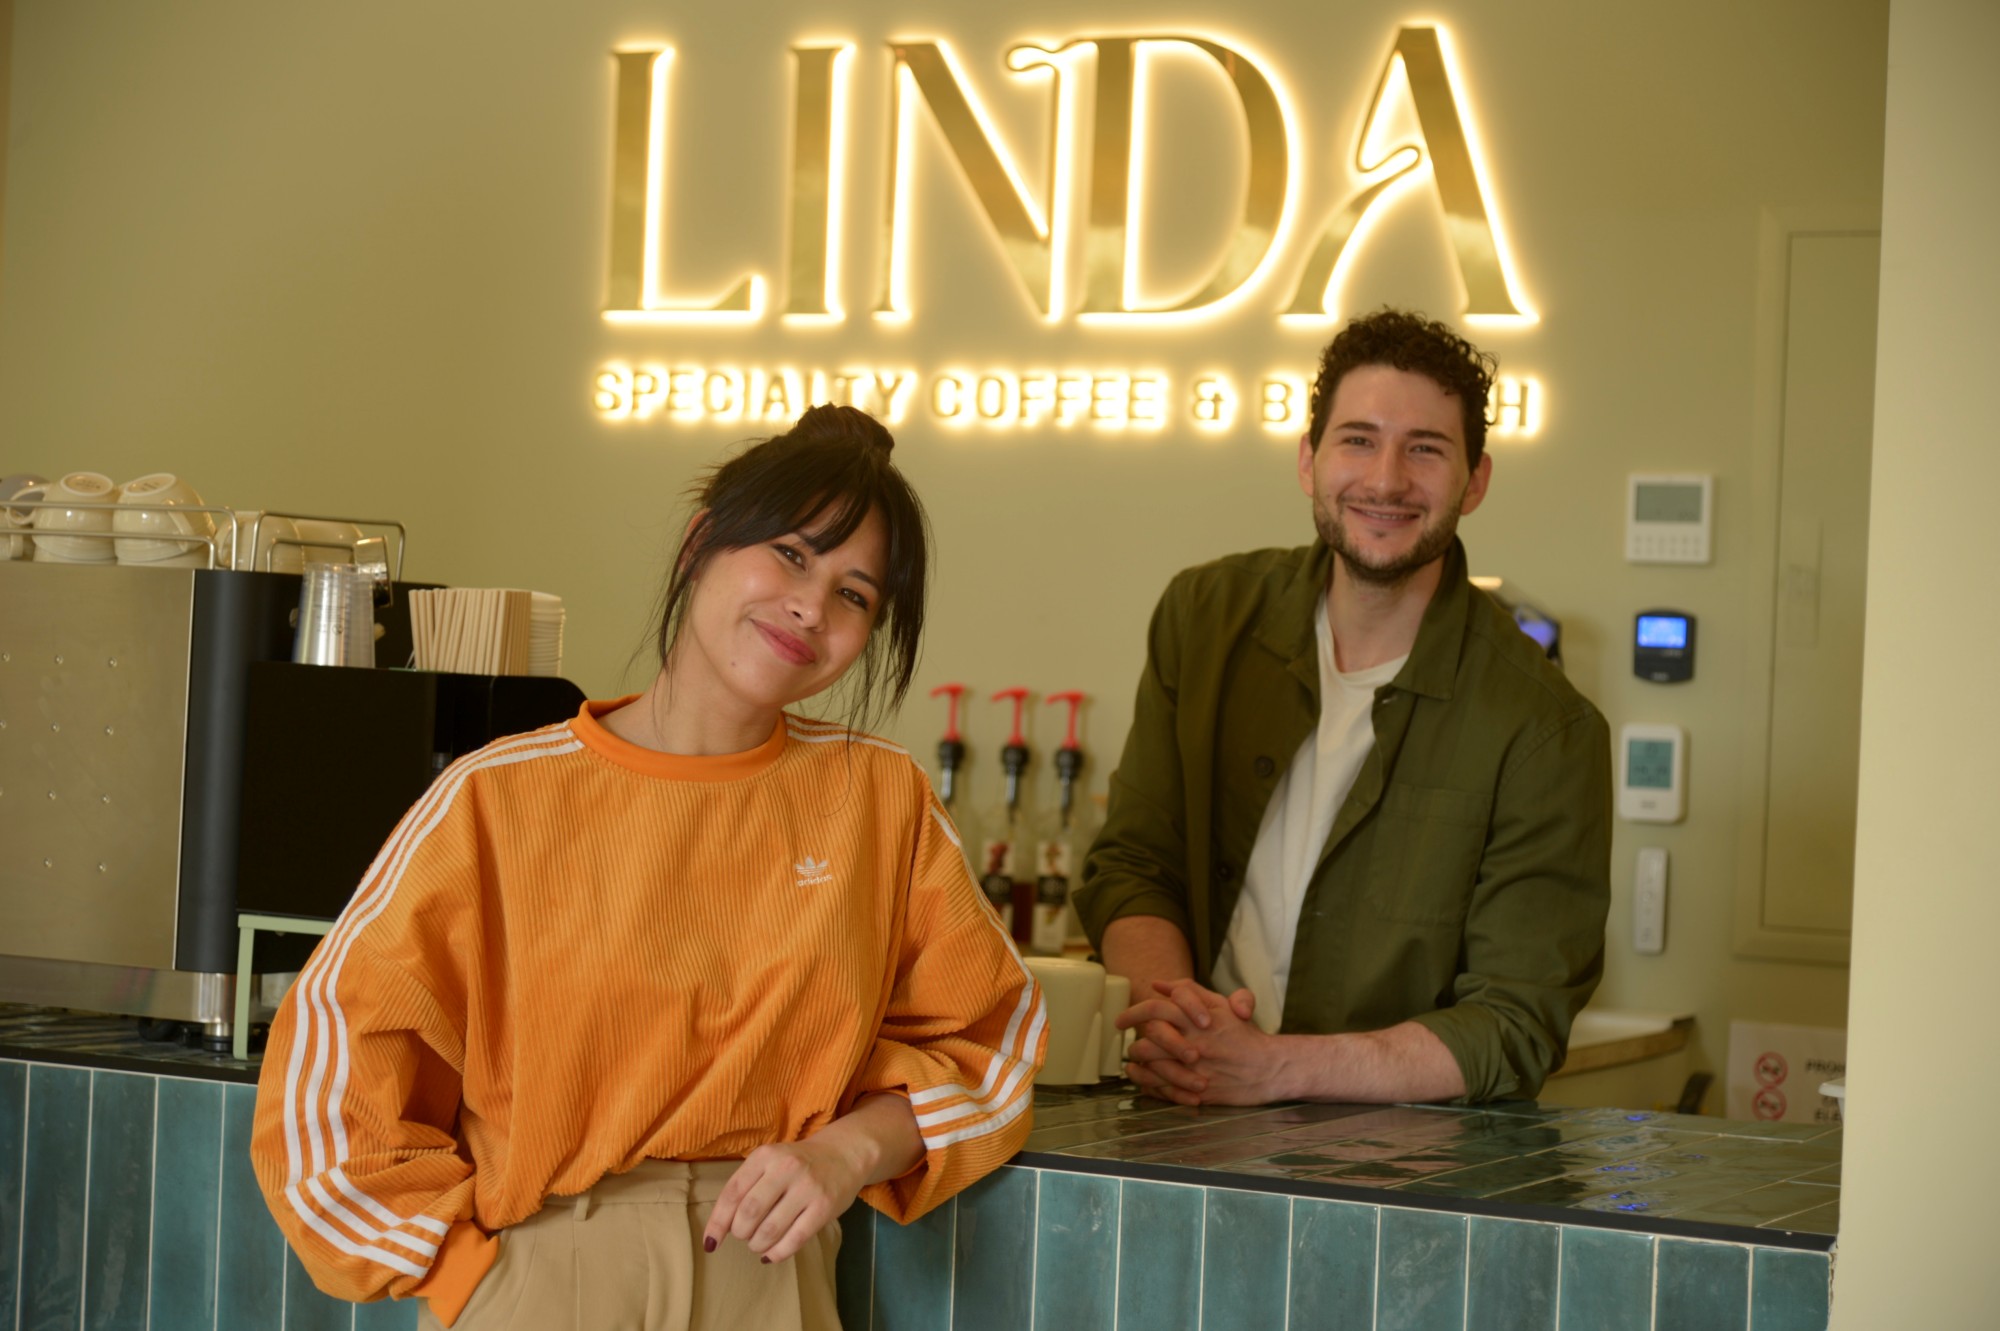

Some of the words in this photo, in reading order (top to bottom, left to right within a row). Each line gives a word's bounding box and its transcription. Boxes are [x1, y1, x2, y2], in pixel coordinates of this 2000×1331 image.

[602, 23, 1539, 325] LINDA
[931, 372, 1164, 426] COFFEE
[1192, 375, 1233, 426] &
